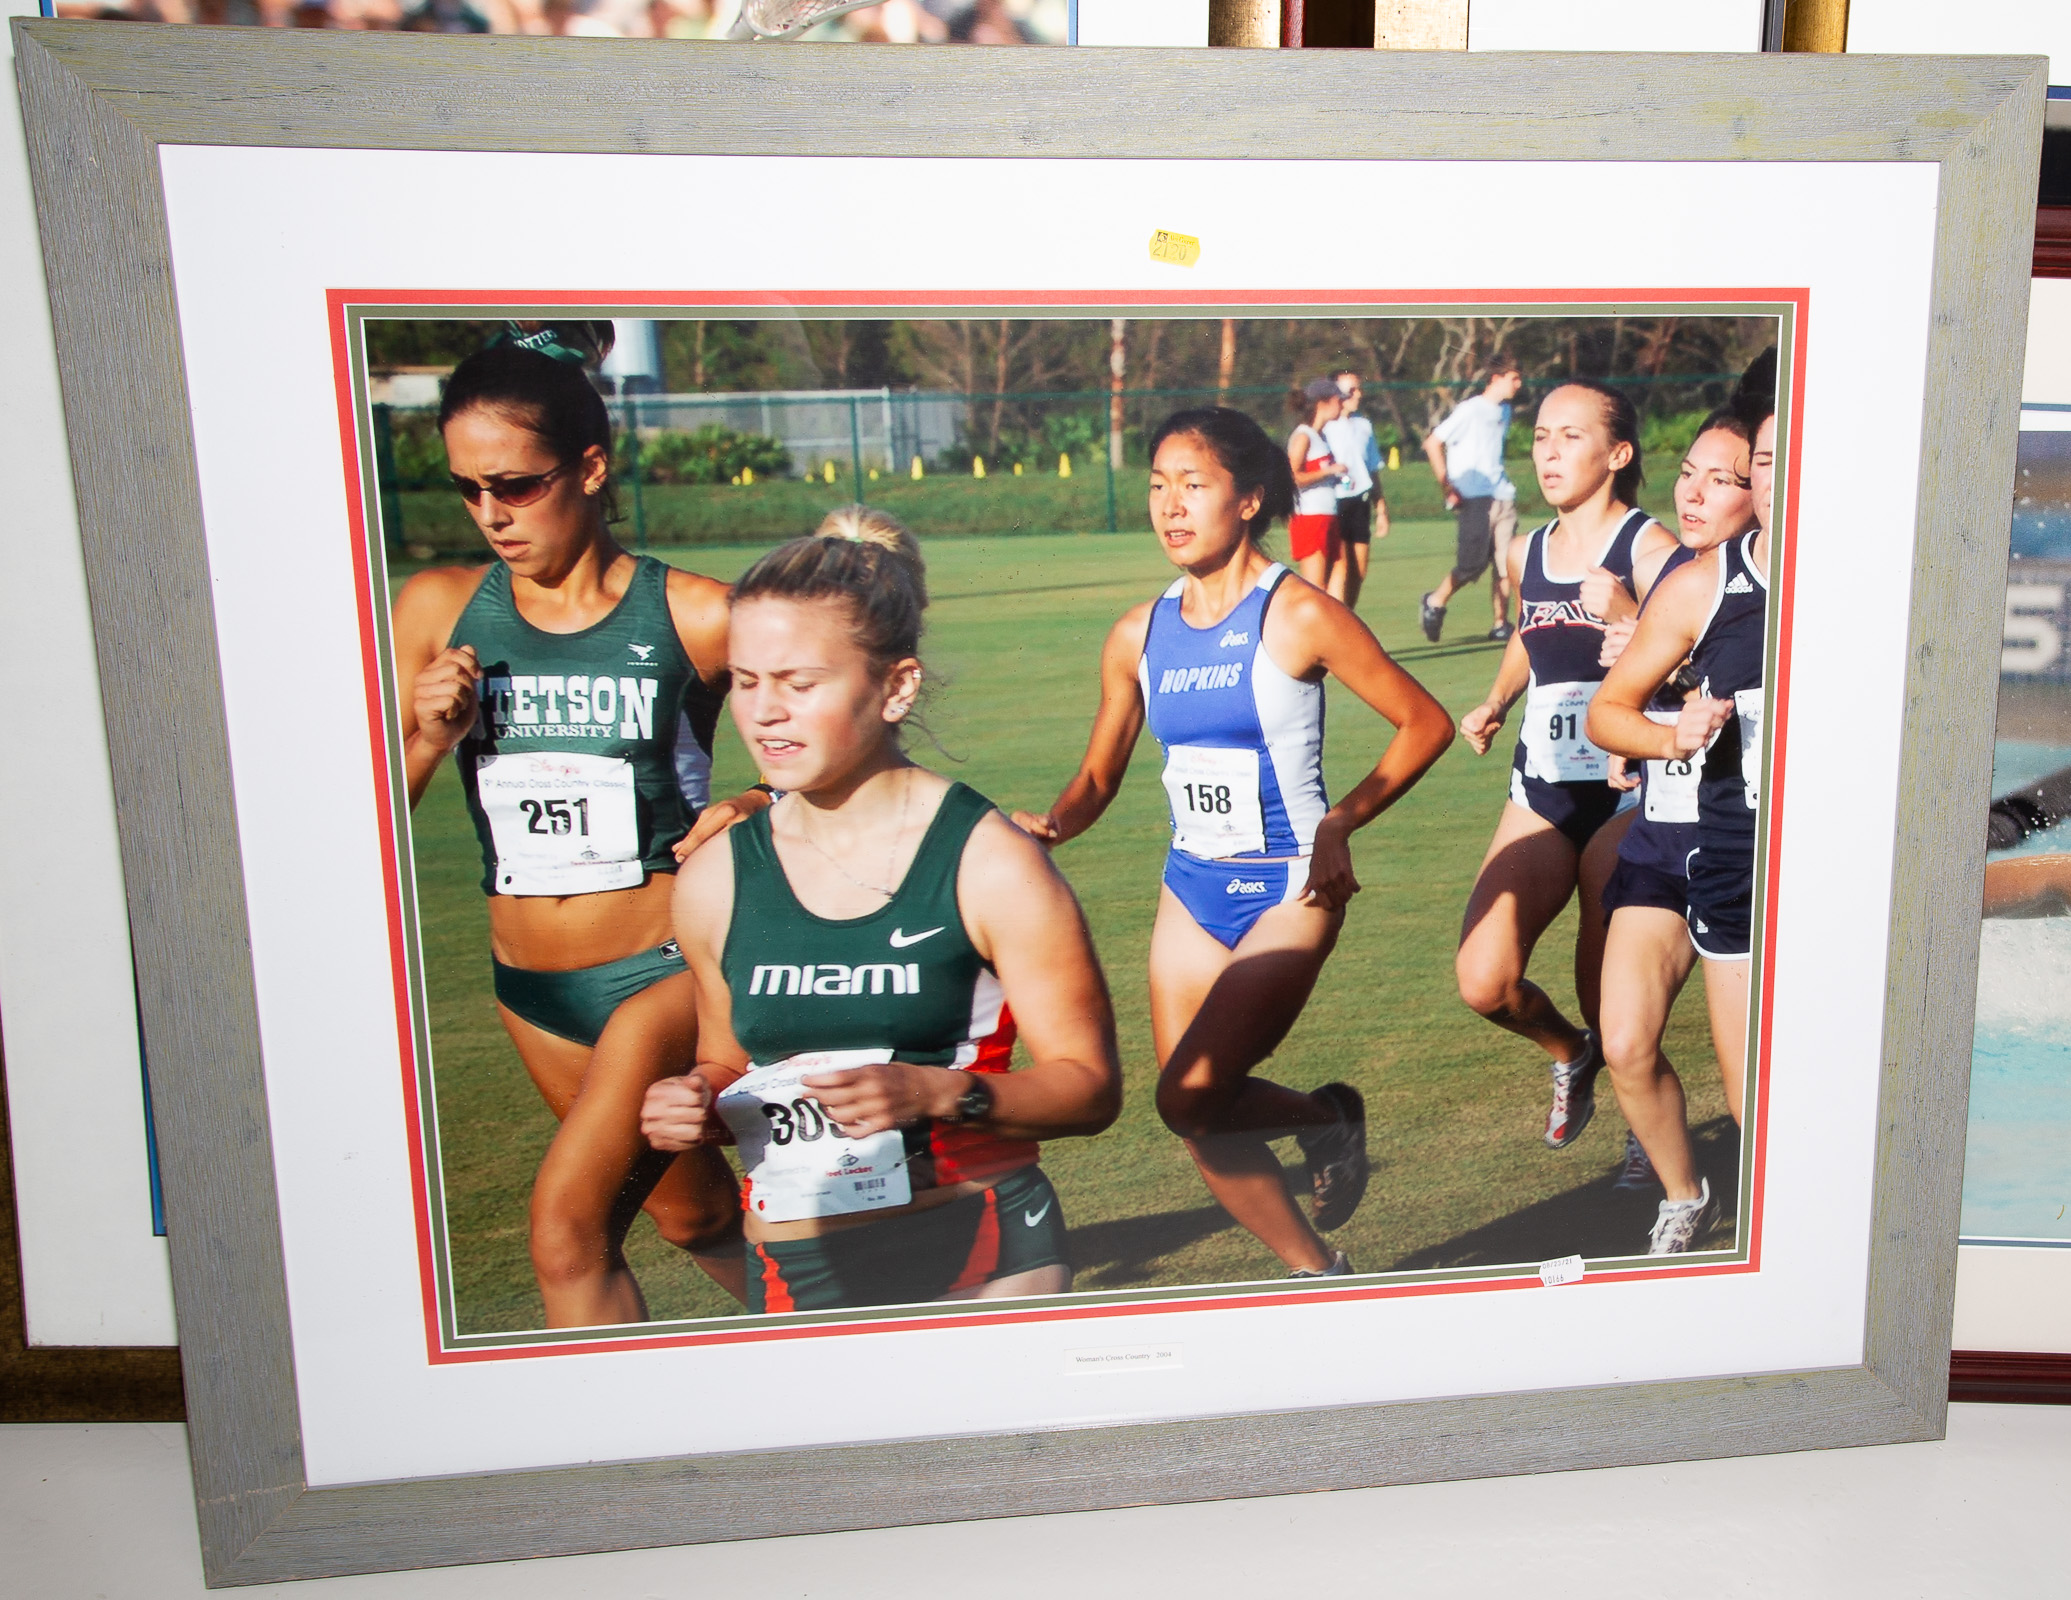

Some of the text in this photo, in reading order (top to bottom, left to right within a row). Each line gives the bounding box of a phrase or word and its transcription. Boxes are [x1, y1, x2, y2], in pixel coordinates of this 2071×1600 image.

[1725, 583, 1754, 594] adidas
[1158, 662, 1243, 694] HOPKINS
[497, 723, 614, 740] UNIVERSITY
[1549, 713, 1577, 741] 91
[1183, 783, 1232, 814] 158
[519, 797, 589, 836] 251
[1105, 1354, 1124, 1362] Cross
[1124, 1353, 1151, 1361] Country
[1156, 1351, 1172, 1359] 2004
